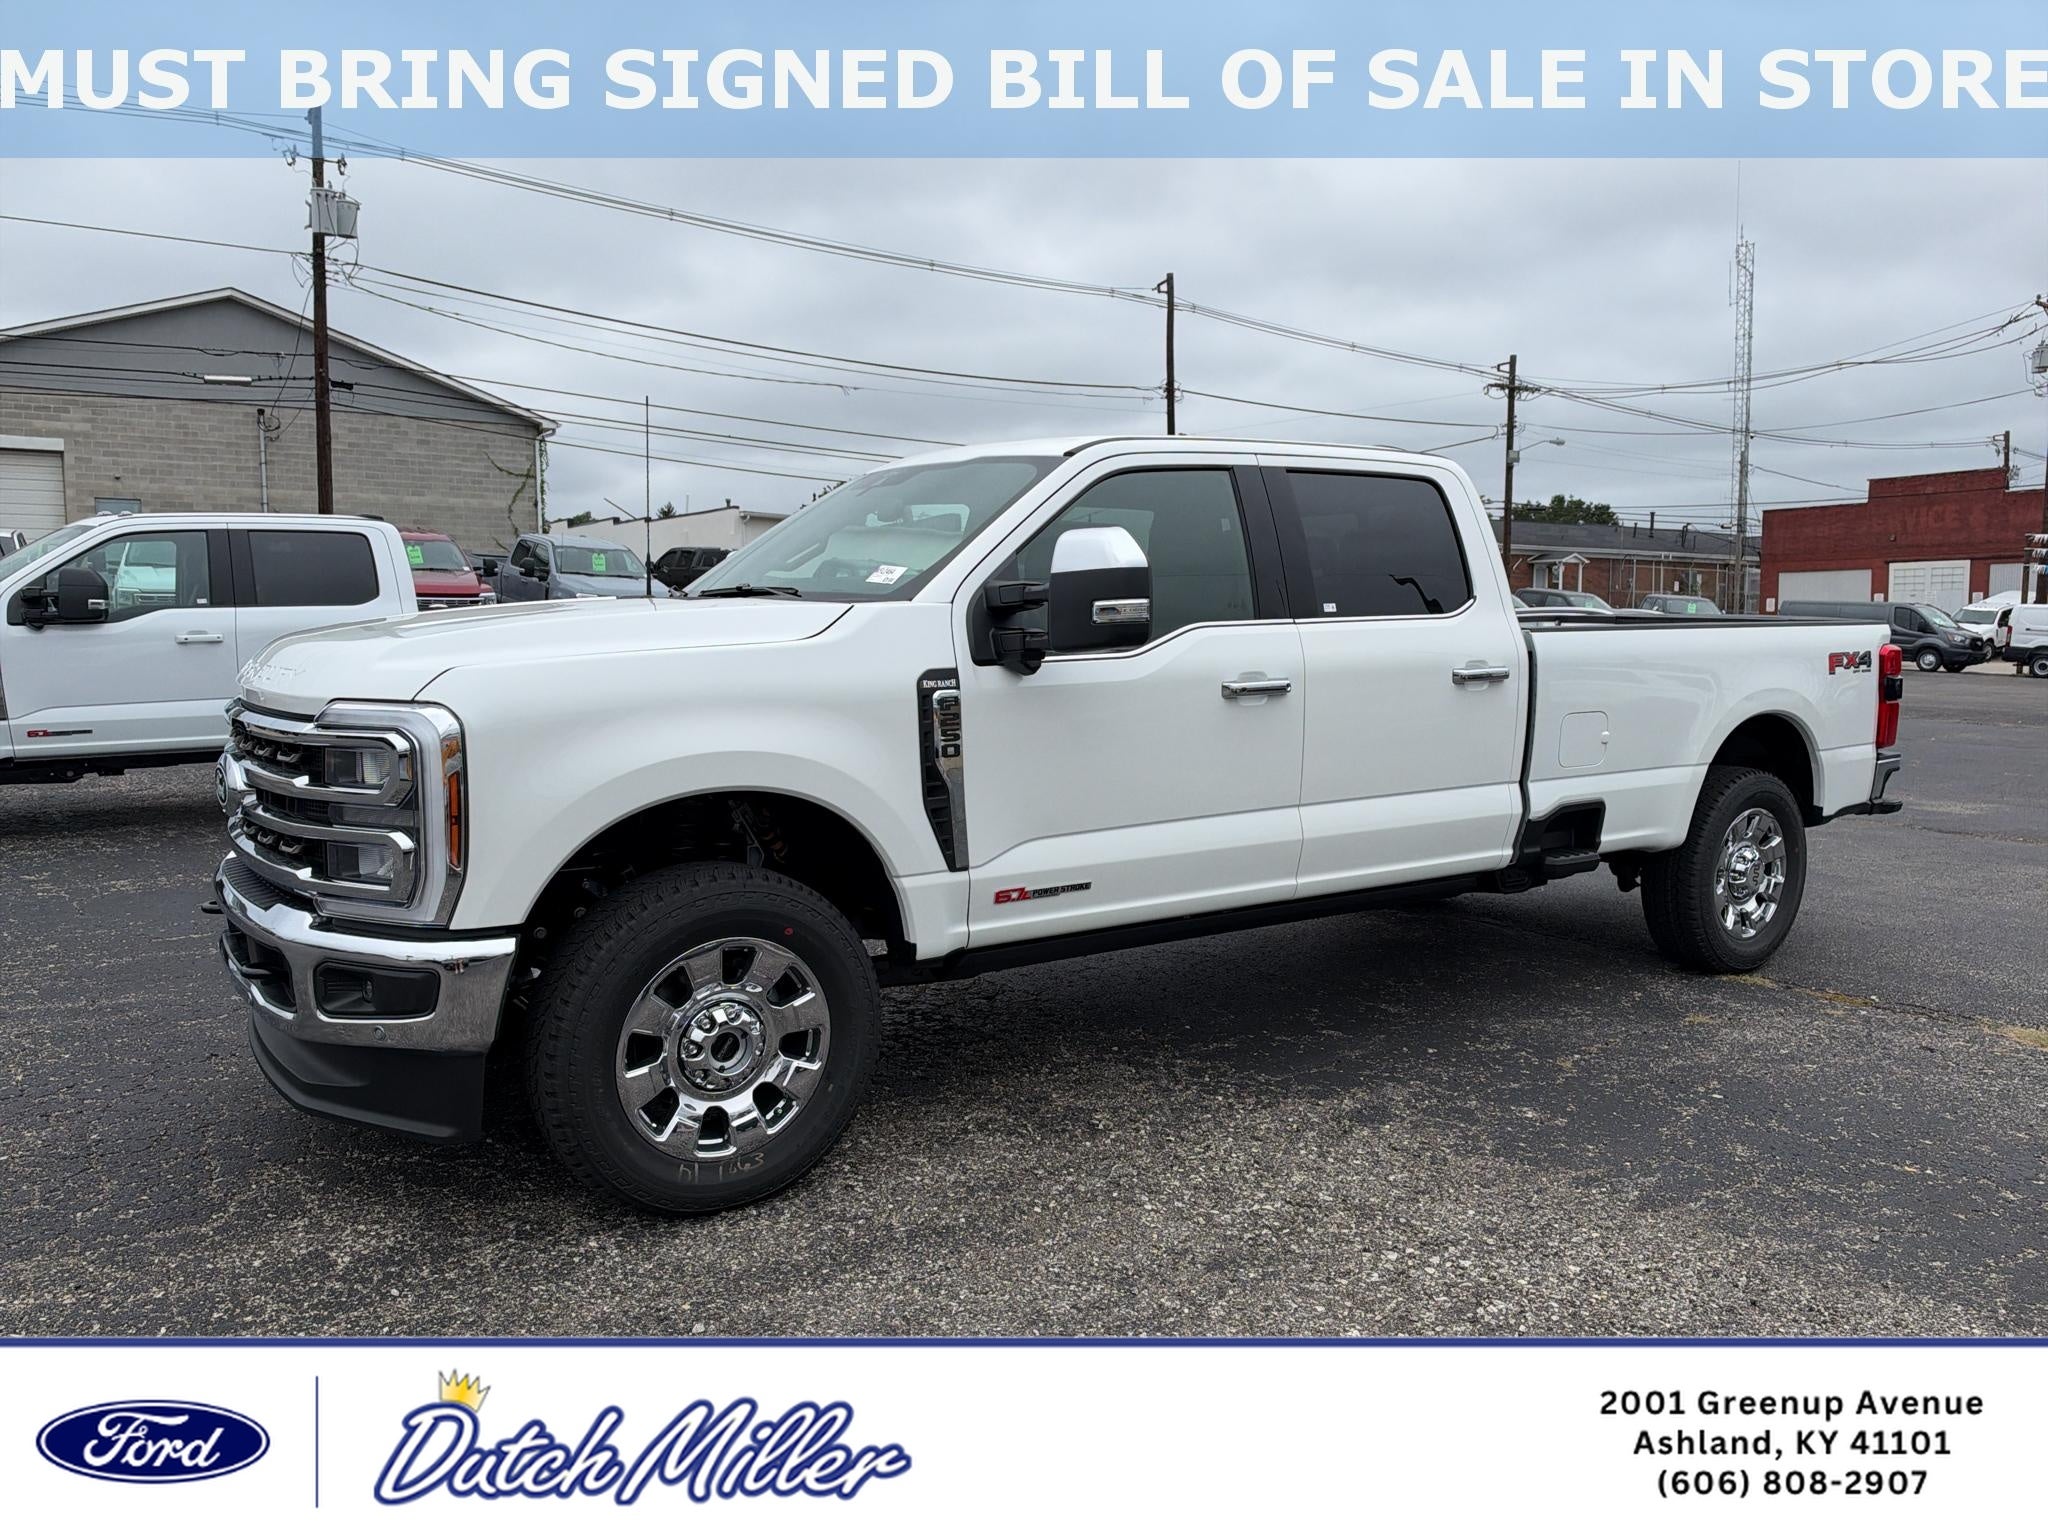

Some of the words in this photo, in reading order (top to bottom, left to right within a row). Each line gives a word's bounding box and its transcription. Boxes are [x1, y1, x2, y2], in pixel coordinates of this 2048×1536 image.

[1829, 650, 1872, 675] FX4
[923, 679, 937, 689] KING
[938, 678, 957, 688] RANCH
[1031, 886, 1060, 898] POWER
[1059, 882, 1093, 894] STROKE
